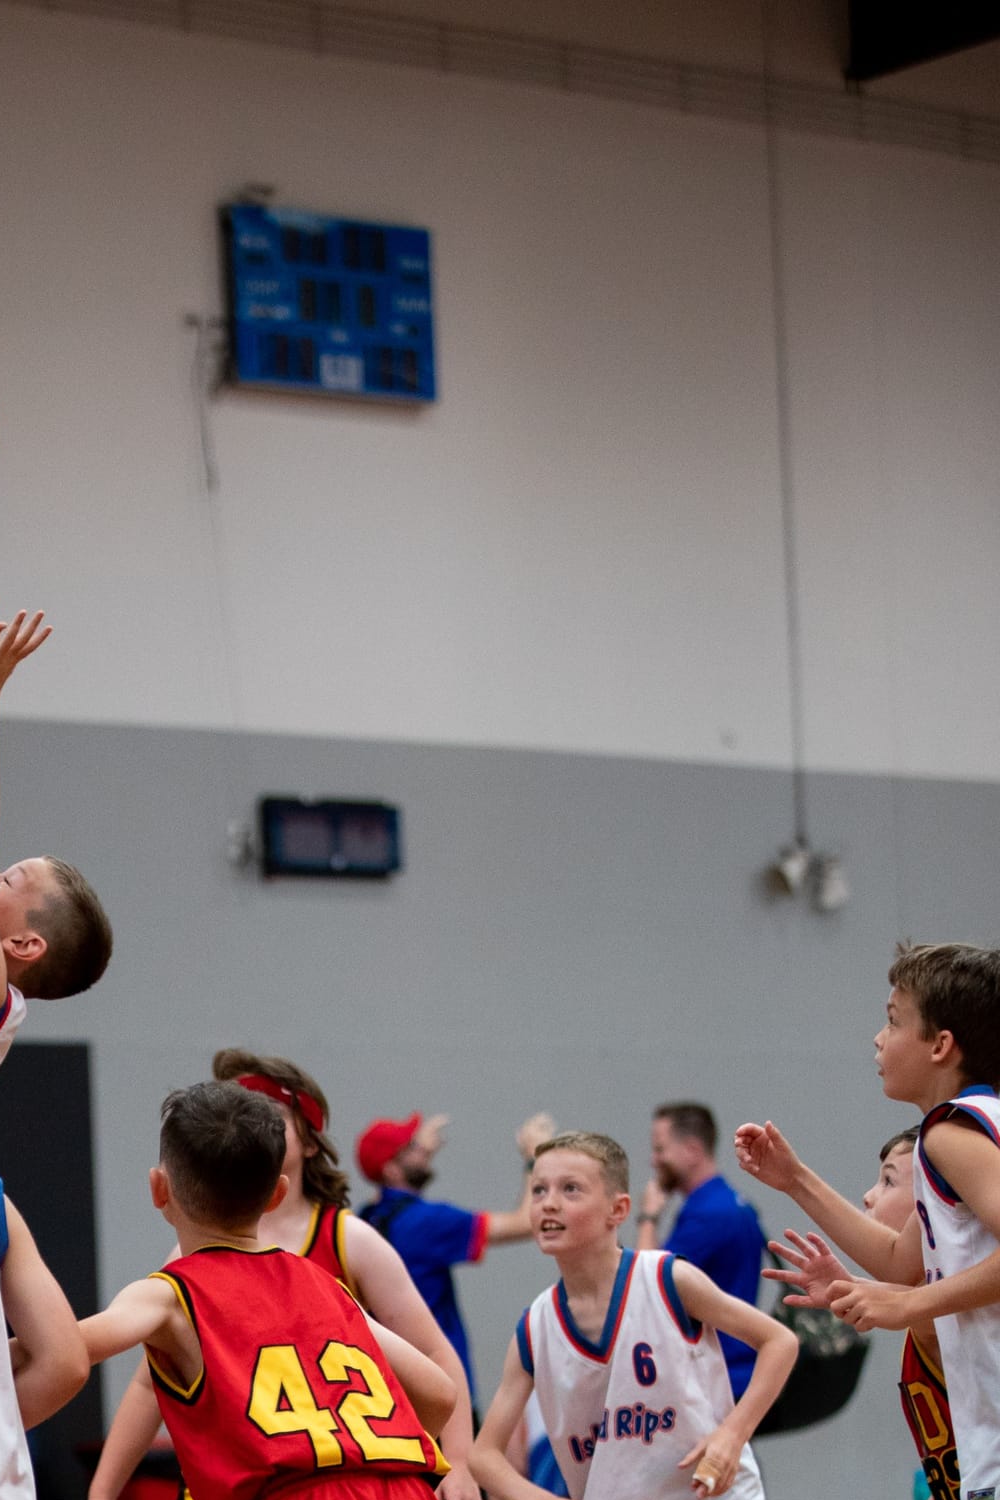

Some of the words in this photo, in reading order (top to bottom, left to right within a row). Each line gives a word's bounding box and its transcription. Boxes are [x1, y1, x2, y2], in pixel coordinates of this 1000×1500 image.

[632, 1341, 657, 1388] 6
[246, 1339, 428, 1469] 42
[614, 1402, 677, 1446] Rips
